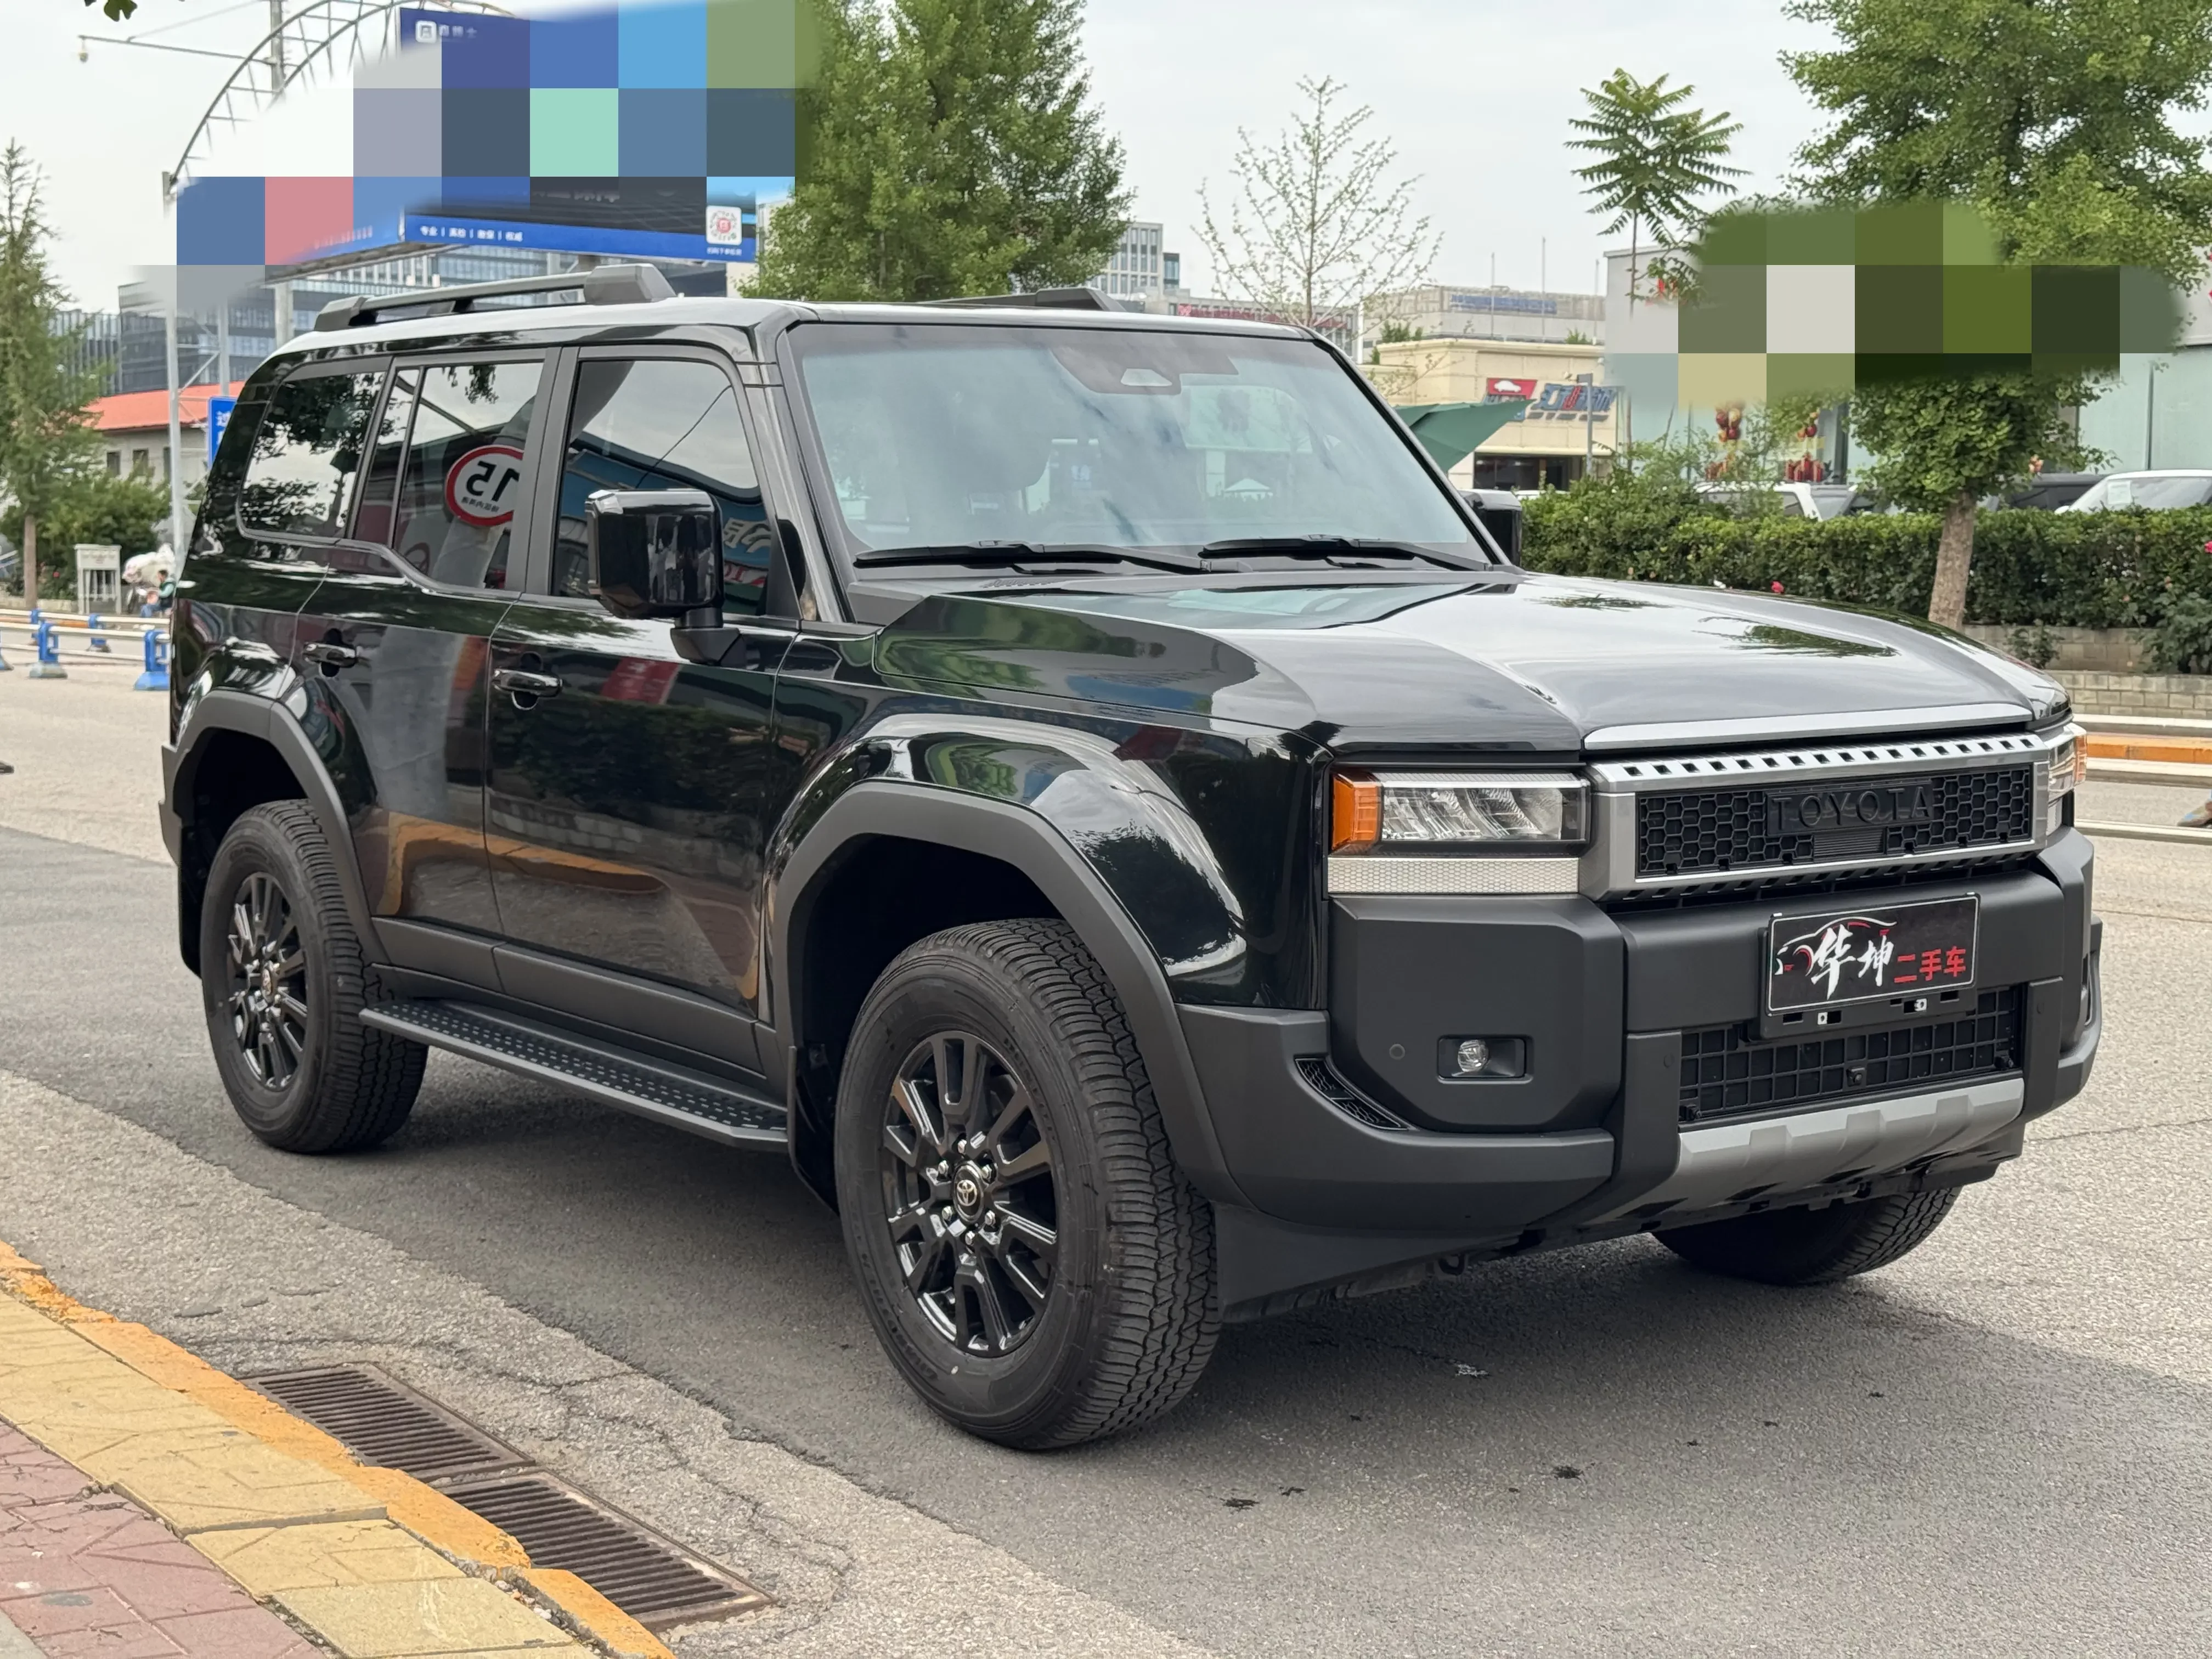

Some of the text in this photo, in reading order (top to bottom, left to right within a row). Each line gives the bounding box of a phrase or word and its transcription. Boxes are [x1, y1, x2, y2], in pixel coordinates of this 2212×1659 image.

[1771, 786, 1931, 830] TOYOTA
[1894, 946, 1966, 984] 二手车
